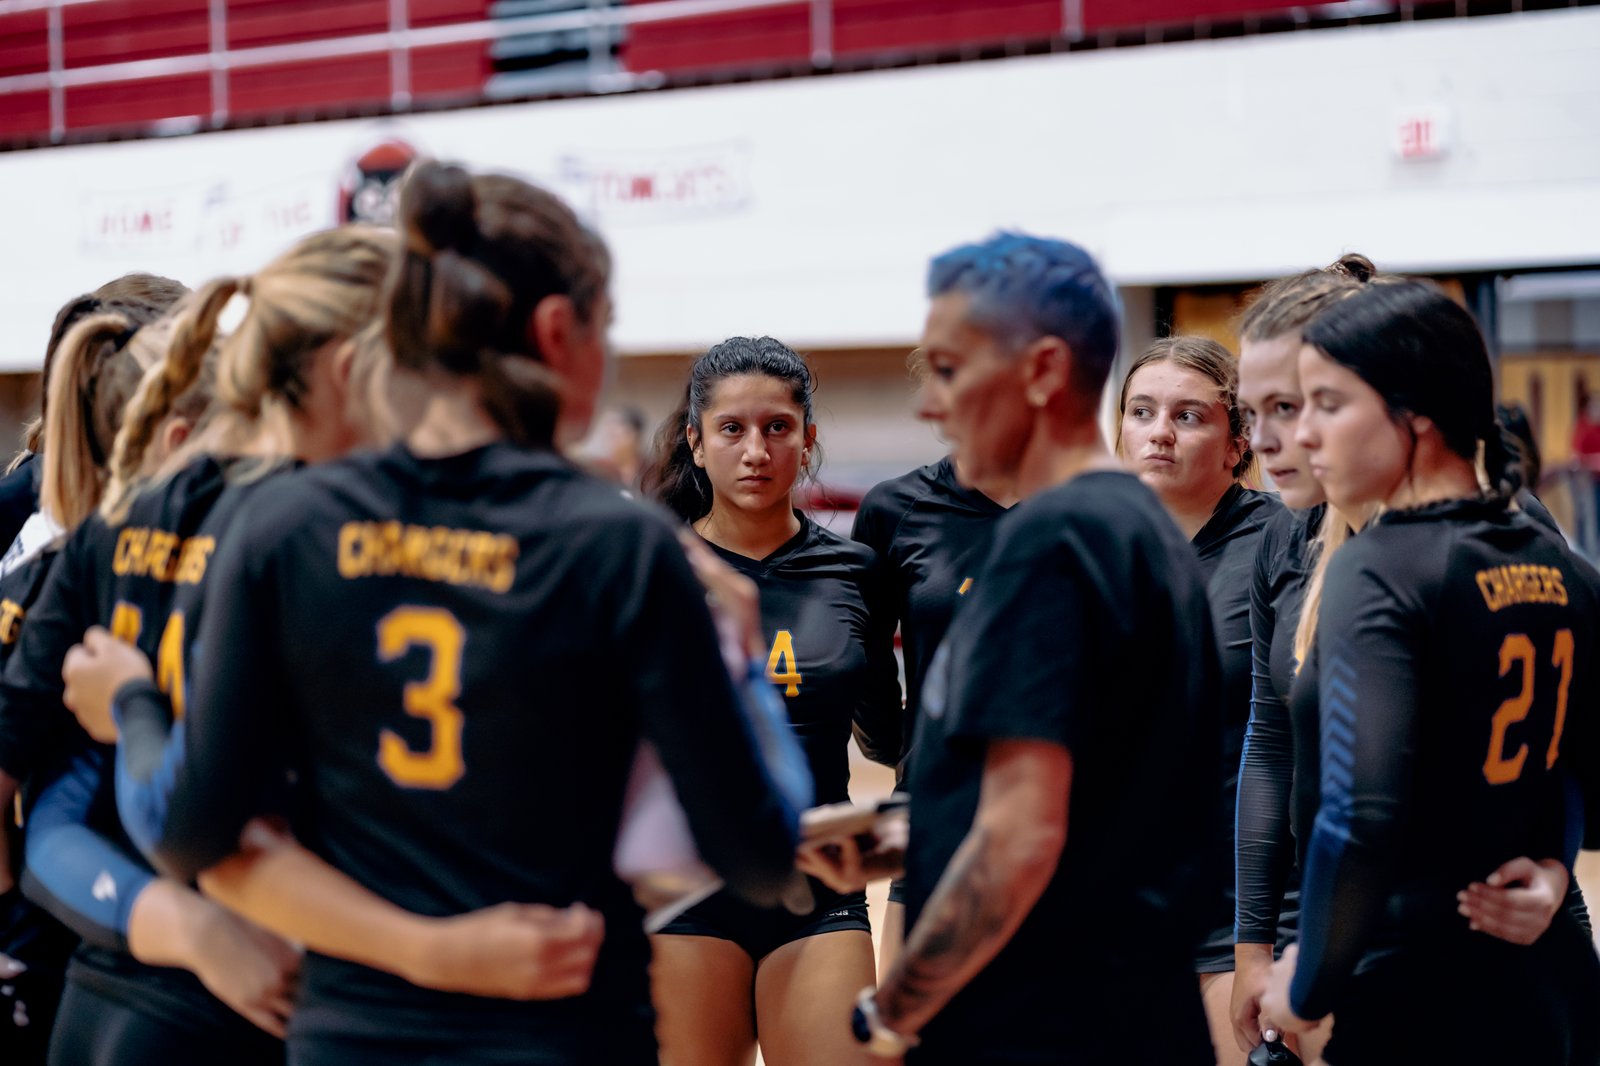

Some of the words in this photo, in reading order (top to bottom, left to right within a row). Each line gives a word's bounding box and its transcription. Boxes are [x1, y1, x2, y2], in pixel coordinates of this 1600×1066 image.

[1475, 563, 1568, 612] CHARGERS
[376, 604, 467, 792] 3
[765, 629, 802, 698] 4
[1482, 627, 1575, 786] 21
